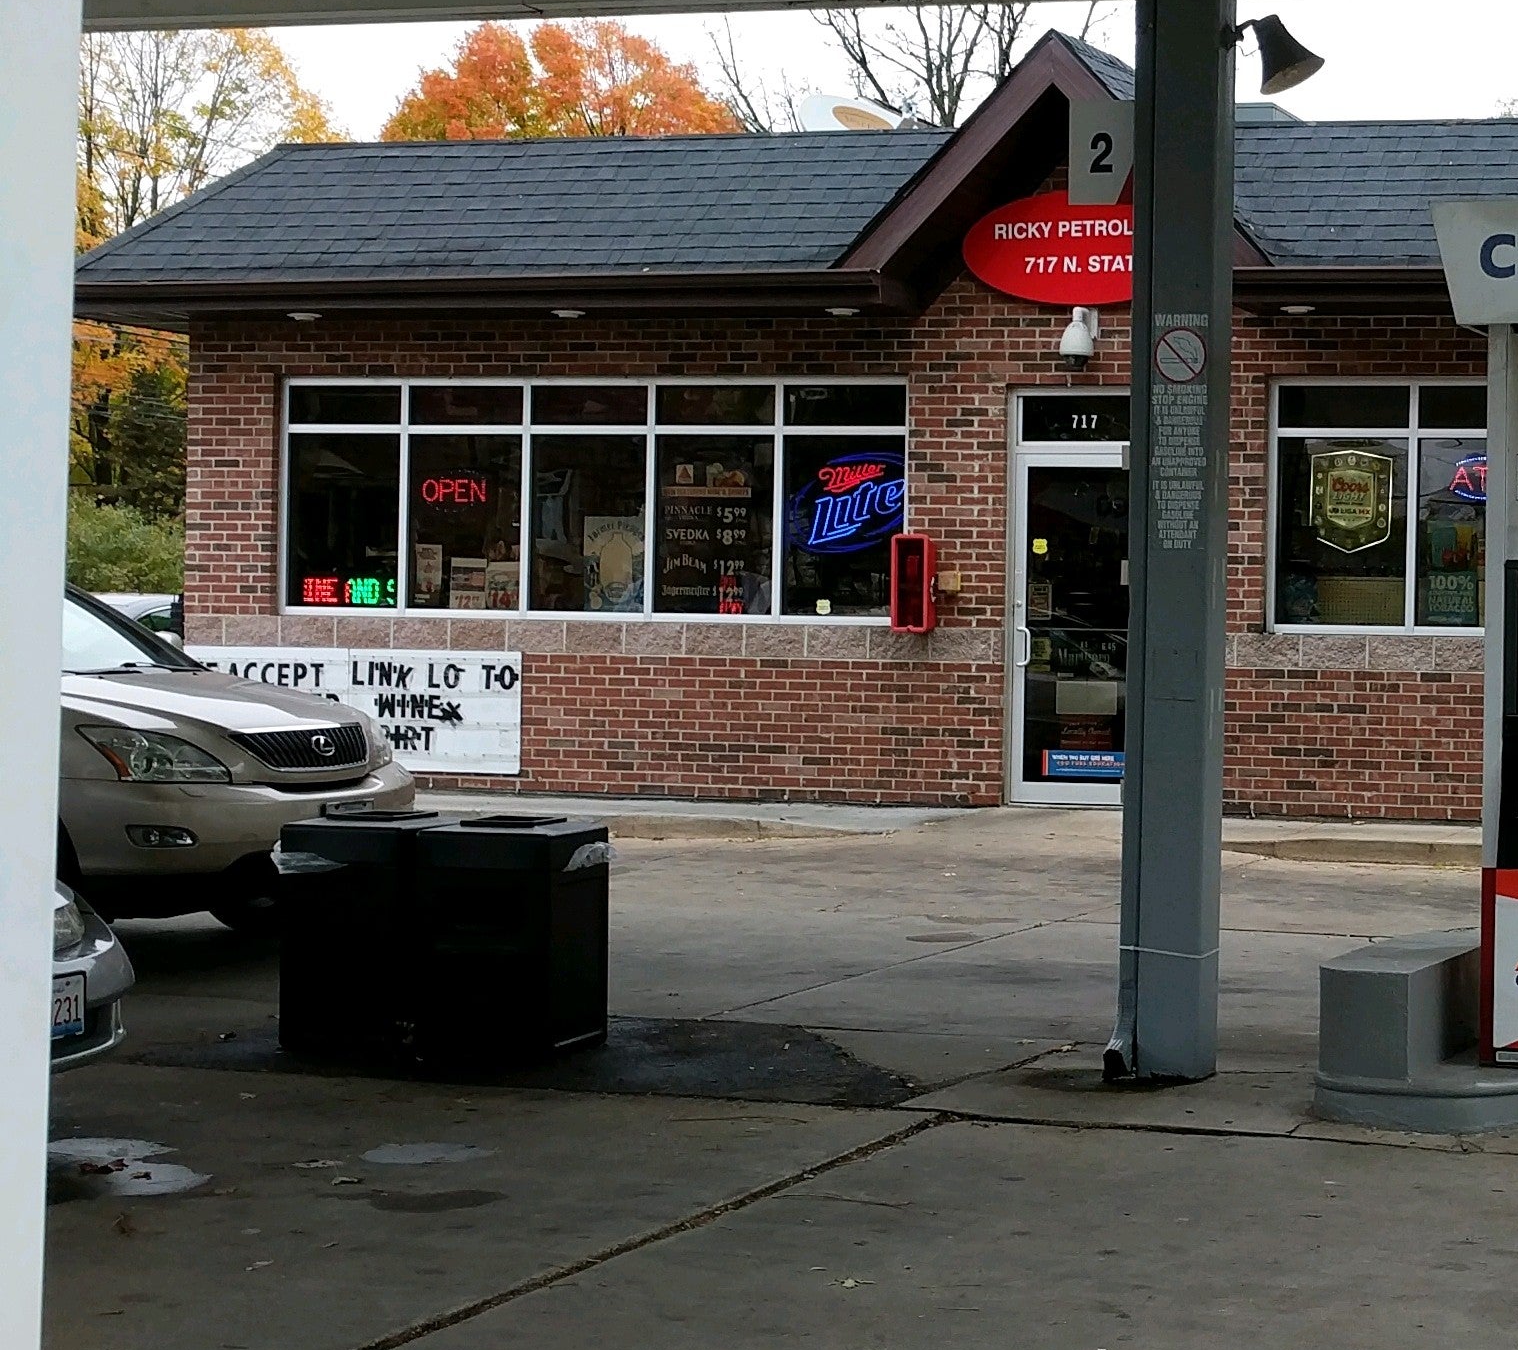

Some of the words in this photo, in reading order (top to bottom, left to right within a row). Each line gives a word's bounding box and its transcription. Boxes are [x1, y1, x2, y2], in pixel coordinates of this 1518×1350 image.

[1089, 132, 1114, 174] 2
[994, 221, 1052, 240] RICKY
[1058, 219, 1134, 238] PETROL
[1024, 257, 1059, 274] 717
[1063, 256, 1082, 272] N.
[1154, 313, 1209, 327] WARNING
[1152, 384, 1165, 395] NO
[1167, 384, 1208, 395] SMOKING
[1151, 394, 1175, 405] STOP
[1177, 394, 1209, 405] ENGINE
[1071, 414, 1098, 429] 717
[818, 463, 887, 492] Miller
[1332, 477, 1370, 493] Coors
[422, 478, 487, 503] OPEN
[664, 505, 713, 515] PINNACLE
[808, 479, 906, 545] Lite
[665, 529, 710, 541] SVEDKA
[1428, 575, 1474, 590] 100%
[229, 662, 324, 687] ACCEPT
[352, 660, 414, 690] LINK
[482, 664, 519, 690] TO
[54, 994, 82, 1027] 231
